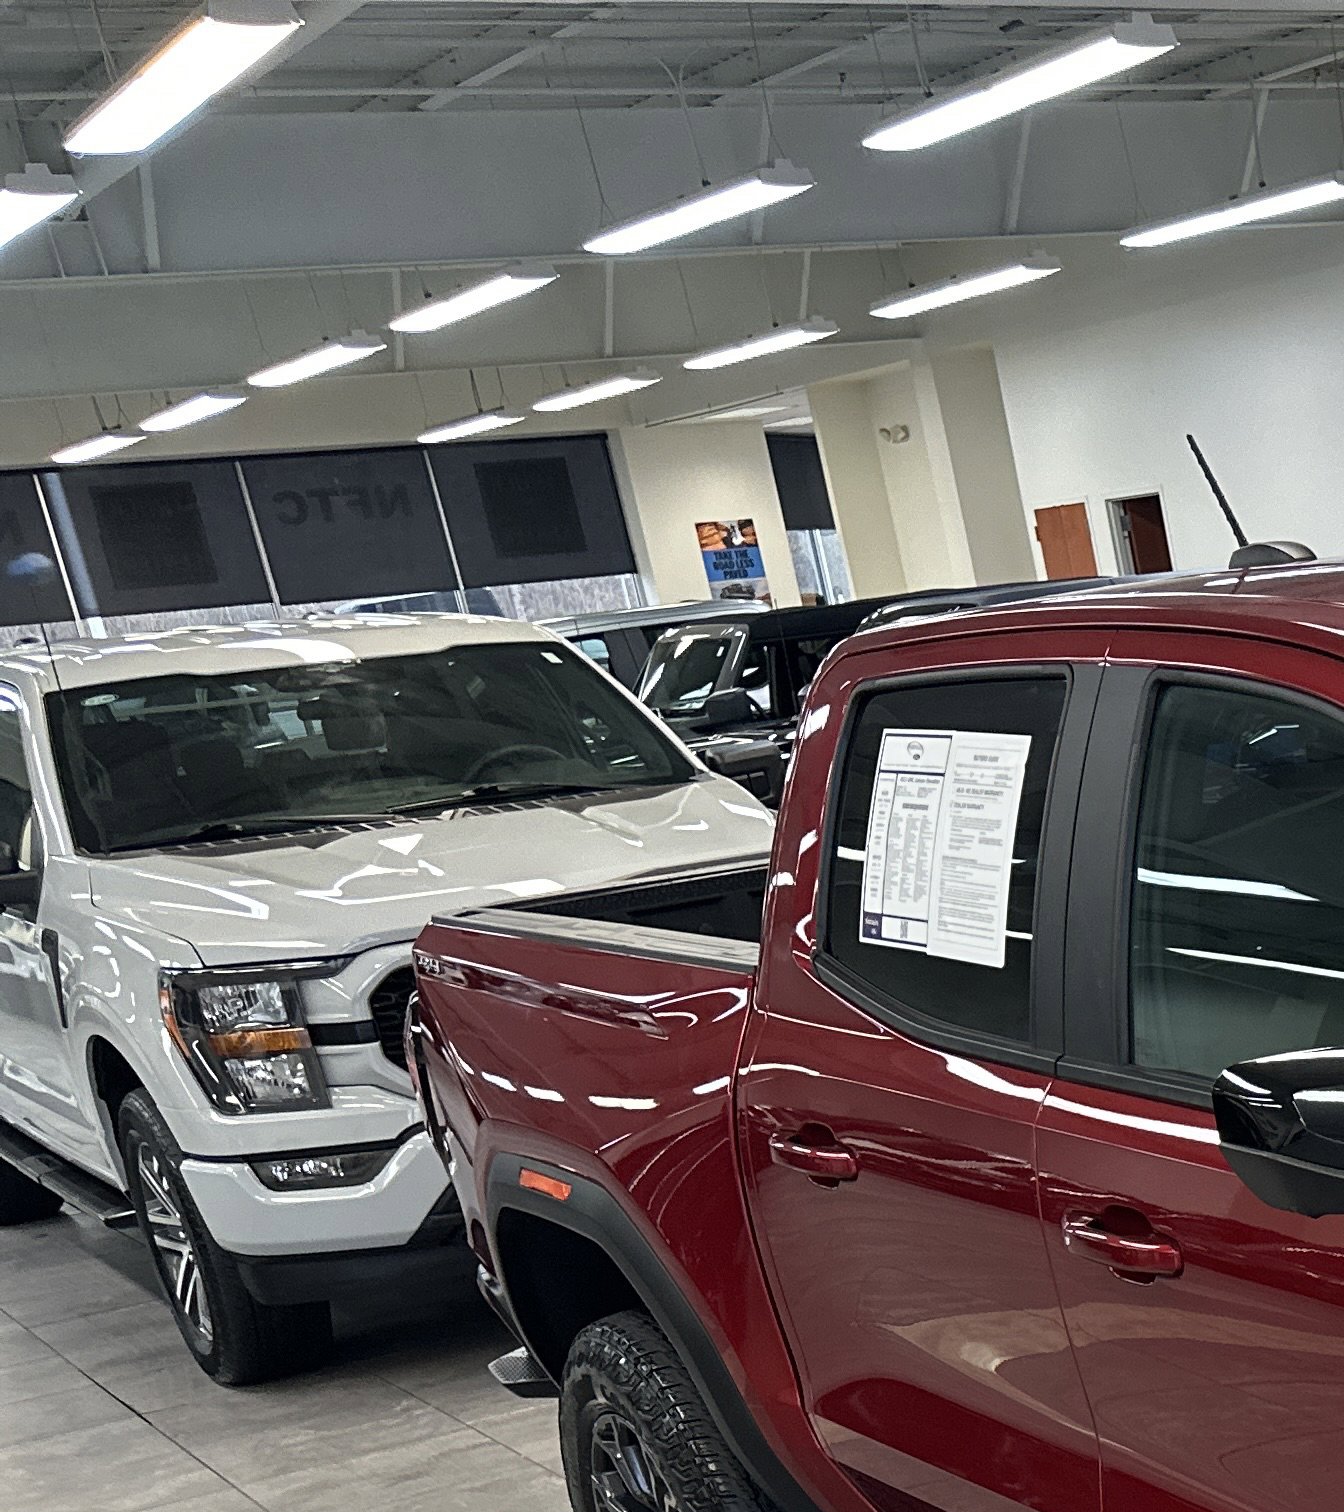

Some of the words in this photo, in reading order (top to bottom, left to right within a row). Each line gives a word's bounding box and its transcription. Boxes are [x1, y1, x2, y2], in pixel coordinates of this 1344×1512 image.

[714, 550, 733, 560] TAKE
[735, 549, 749, 558] THE
[713, 561, 735, 570] ROAD
[737, 558, 755, 568] LESS
[724, 570, 749, 580] PAVED
